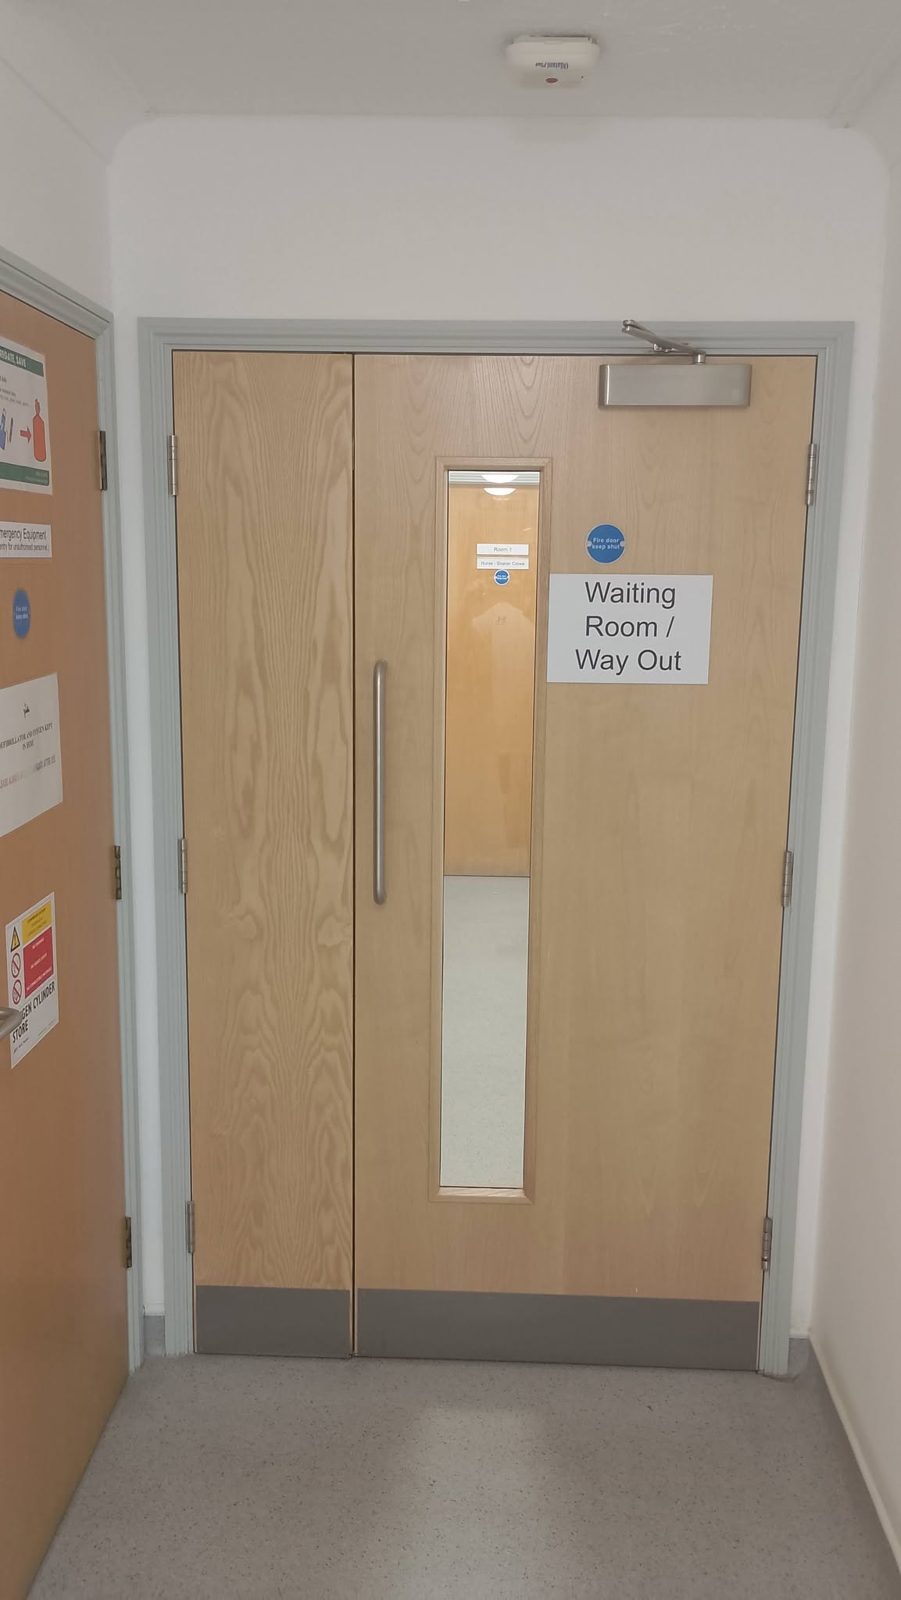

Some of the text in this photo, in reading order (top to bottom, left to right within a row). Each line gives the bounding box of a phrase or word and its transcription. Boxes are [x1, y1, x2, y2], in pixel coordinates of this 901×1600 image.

[0, 528, 47, 541] mergency Equipment
[585, 581, 676, 609] Waiting
[585, 615, 675, 638] Room /
[575, 648, 682, 676] Way Out
[21, 980, 56, 1020] GEN CYLINDER
[12, 1020, 29, 1043] STORE
